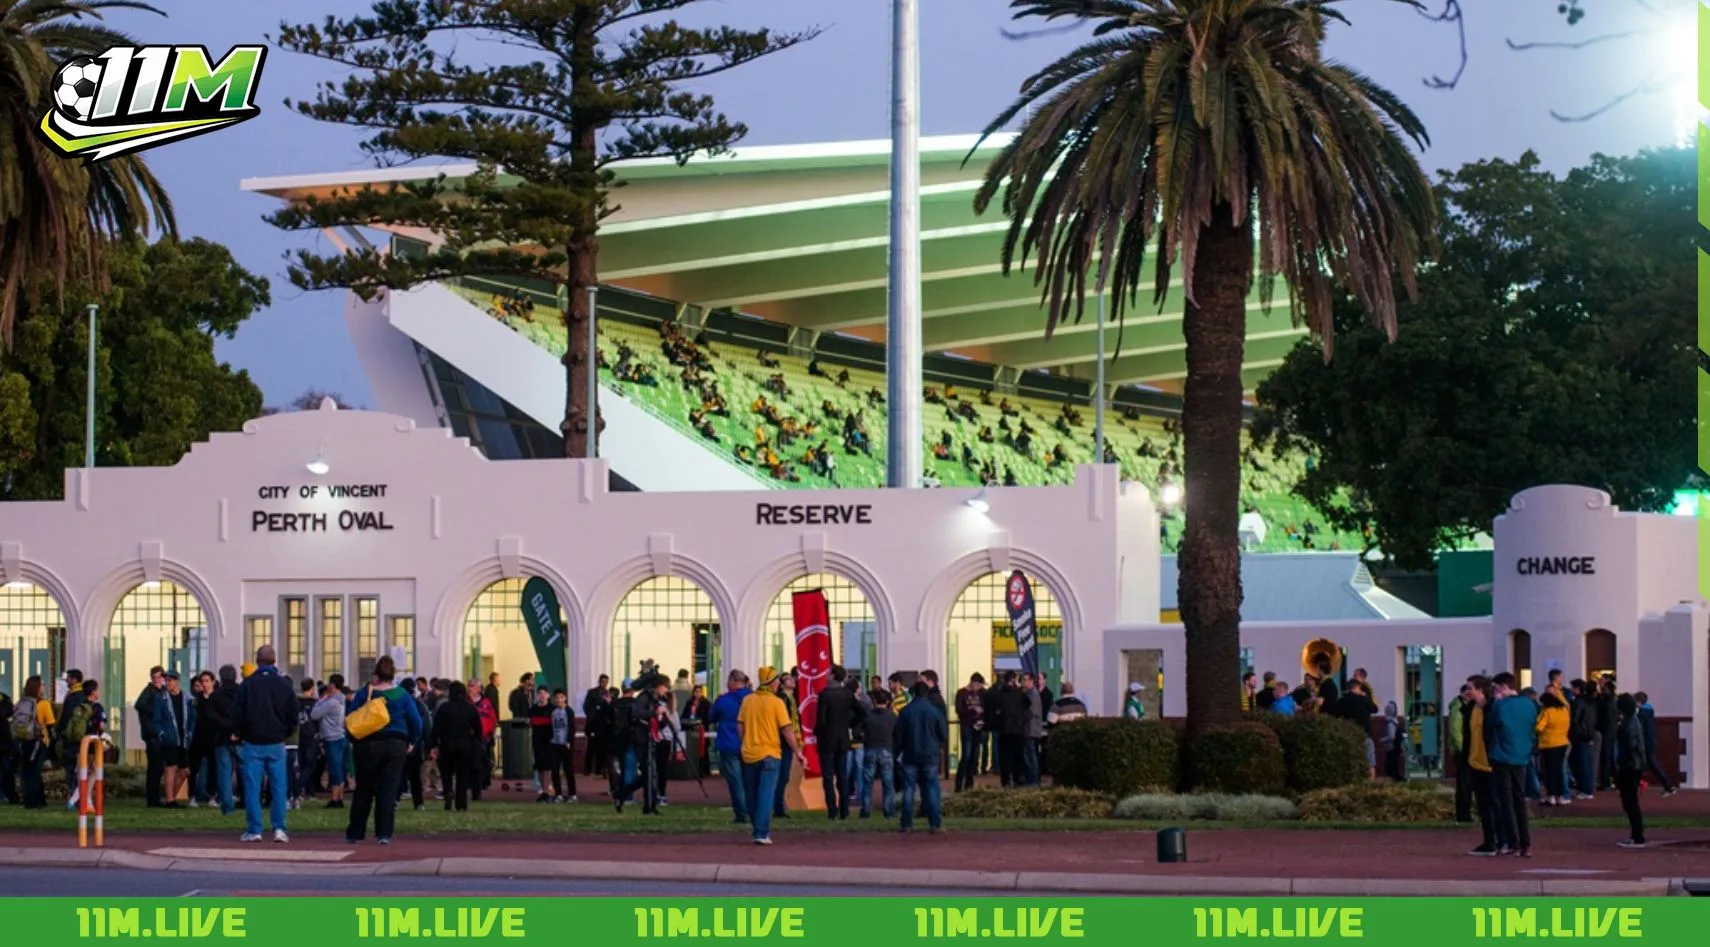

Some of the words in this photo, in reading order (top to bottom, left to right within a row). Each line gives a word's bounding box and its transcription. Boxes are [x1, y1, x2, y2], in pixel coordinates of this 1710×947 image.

[258, 486, 290, 499] CITY
[299, 485, 318, 499] OF
[328, 484, 388, 498] VINCENT
[252, 510, 327, 532] PERTH
[338, 509, 394, 531] OVAL
[756, 502, 873, 525] RESERVE
[1516, 556, 1596, 575] CHANGE
[531, 592, 553, 634] GATE
[546, 629, 561, 648] 1
